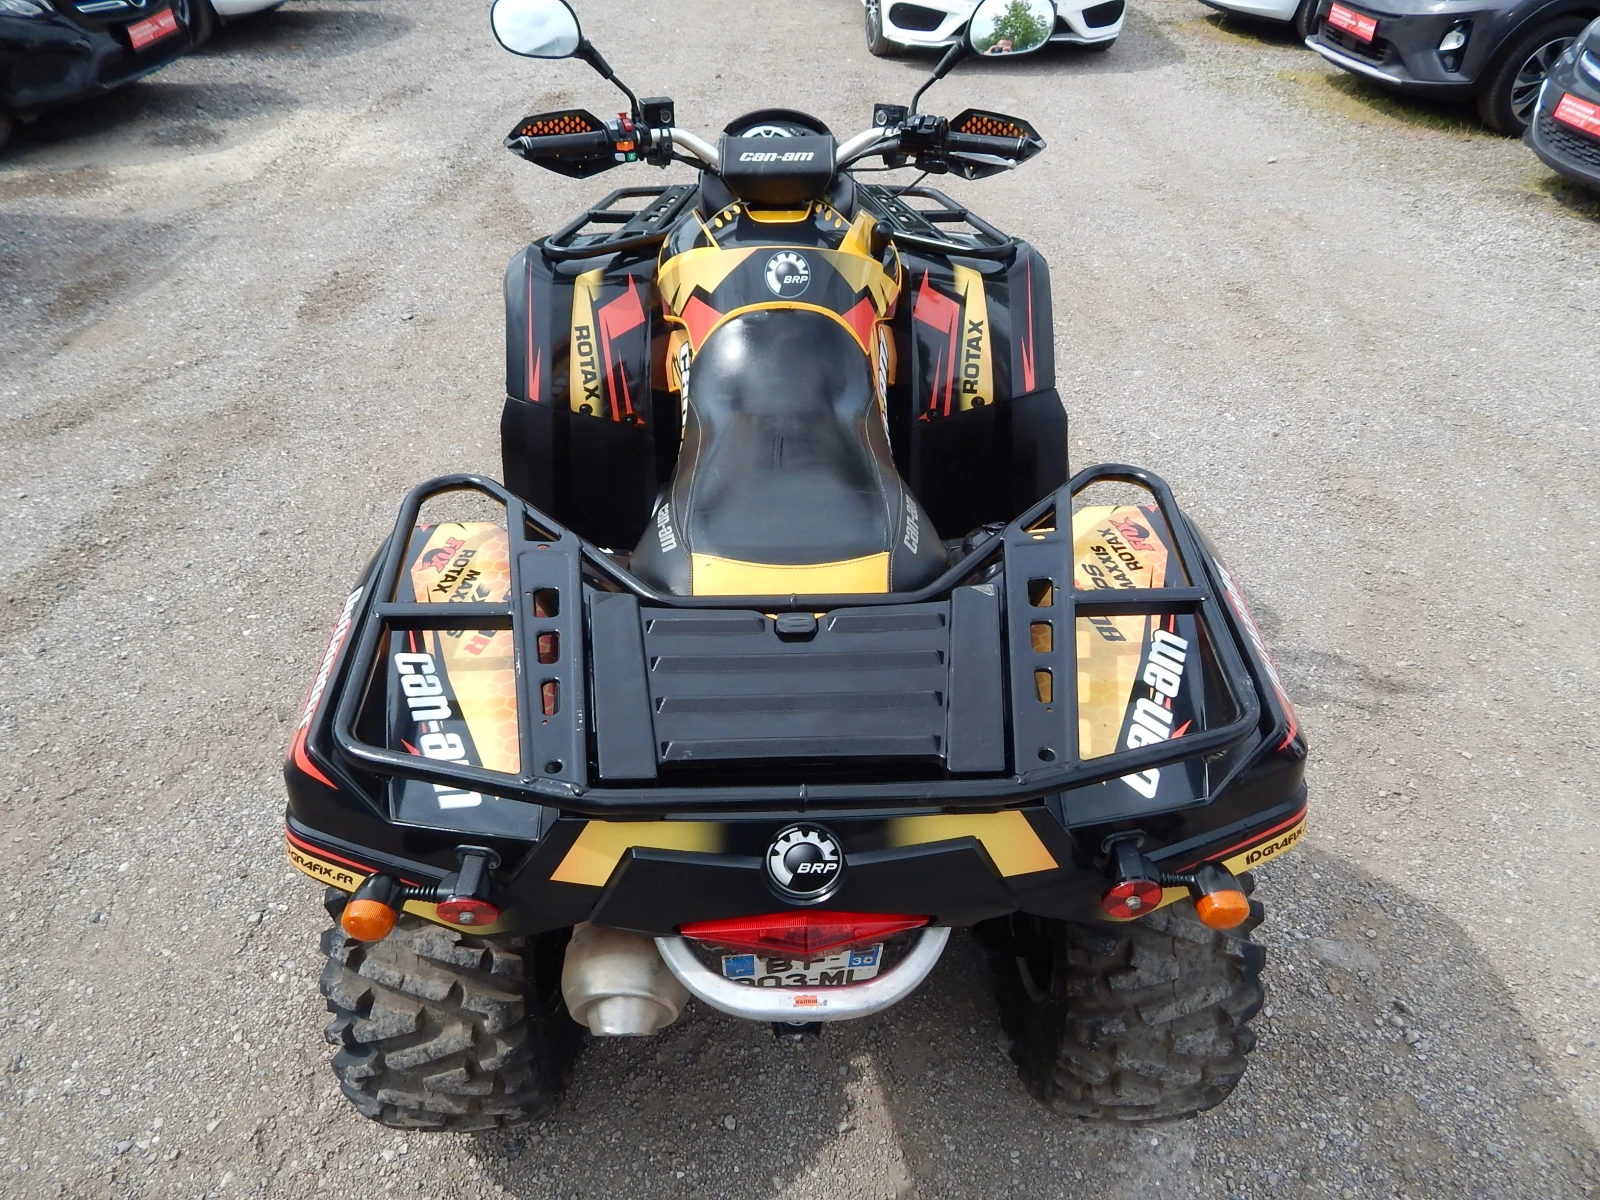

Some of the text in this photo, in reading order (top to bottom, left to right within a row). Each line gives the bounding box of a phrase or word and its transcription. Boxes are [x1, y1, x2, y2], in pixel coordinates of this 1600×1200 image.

[740, 151, 814, 162] can-am
[783, 275, 809, 284] BRP
[574, 324, 601, 402] ROTAX
[962, 319, 984, 394] ROTAX
[1096, 527, 1144, 572] ROTAX
[1108, 517, 1155, 551] FOX
[422, 536, 466, 574] FOX
[431, 549, 477, 594] ROTAX
[796, 862, 838, 874] BRP
